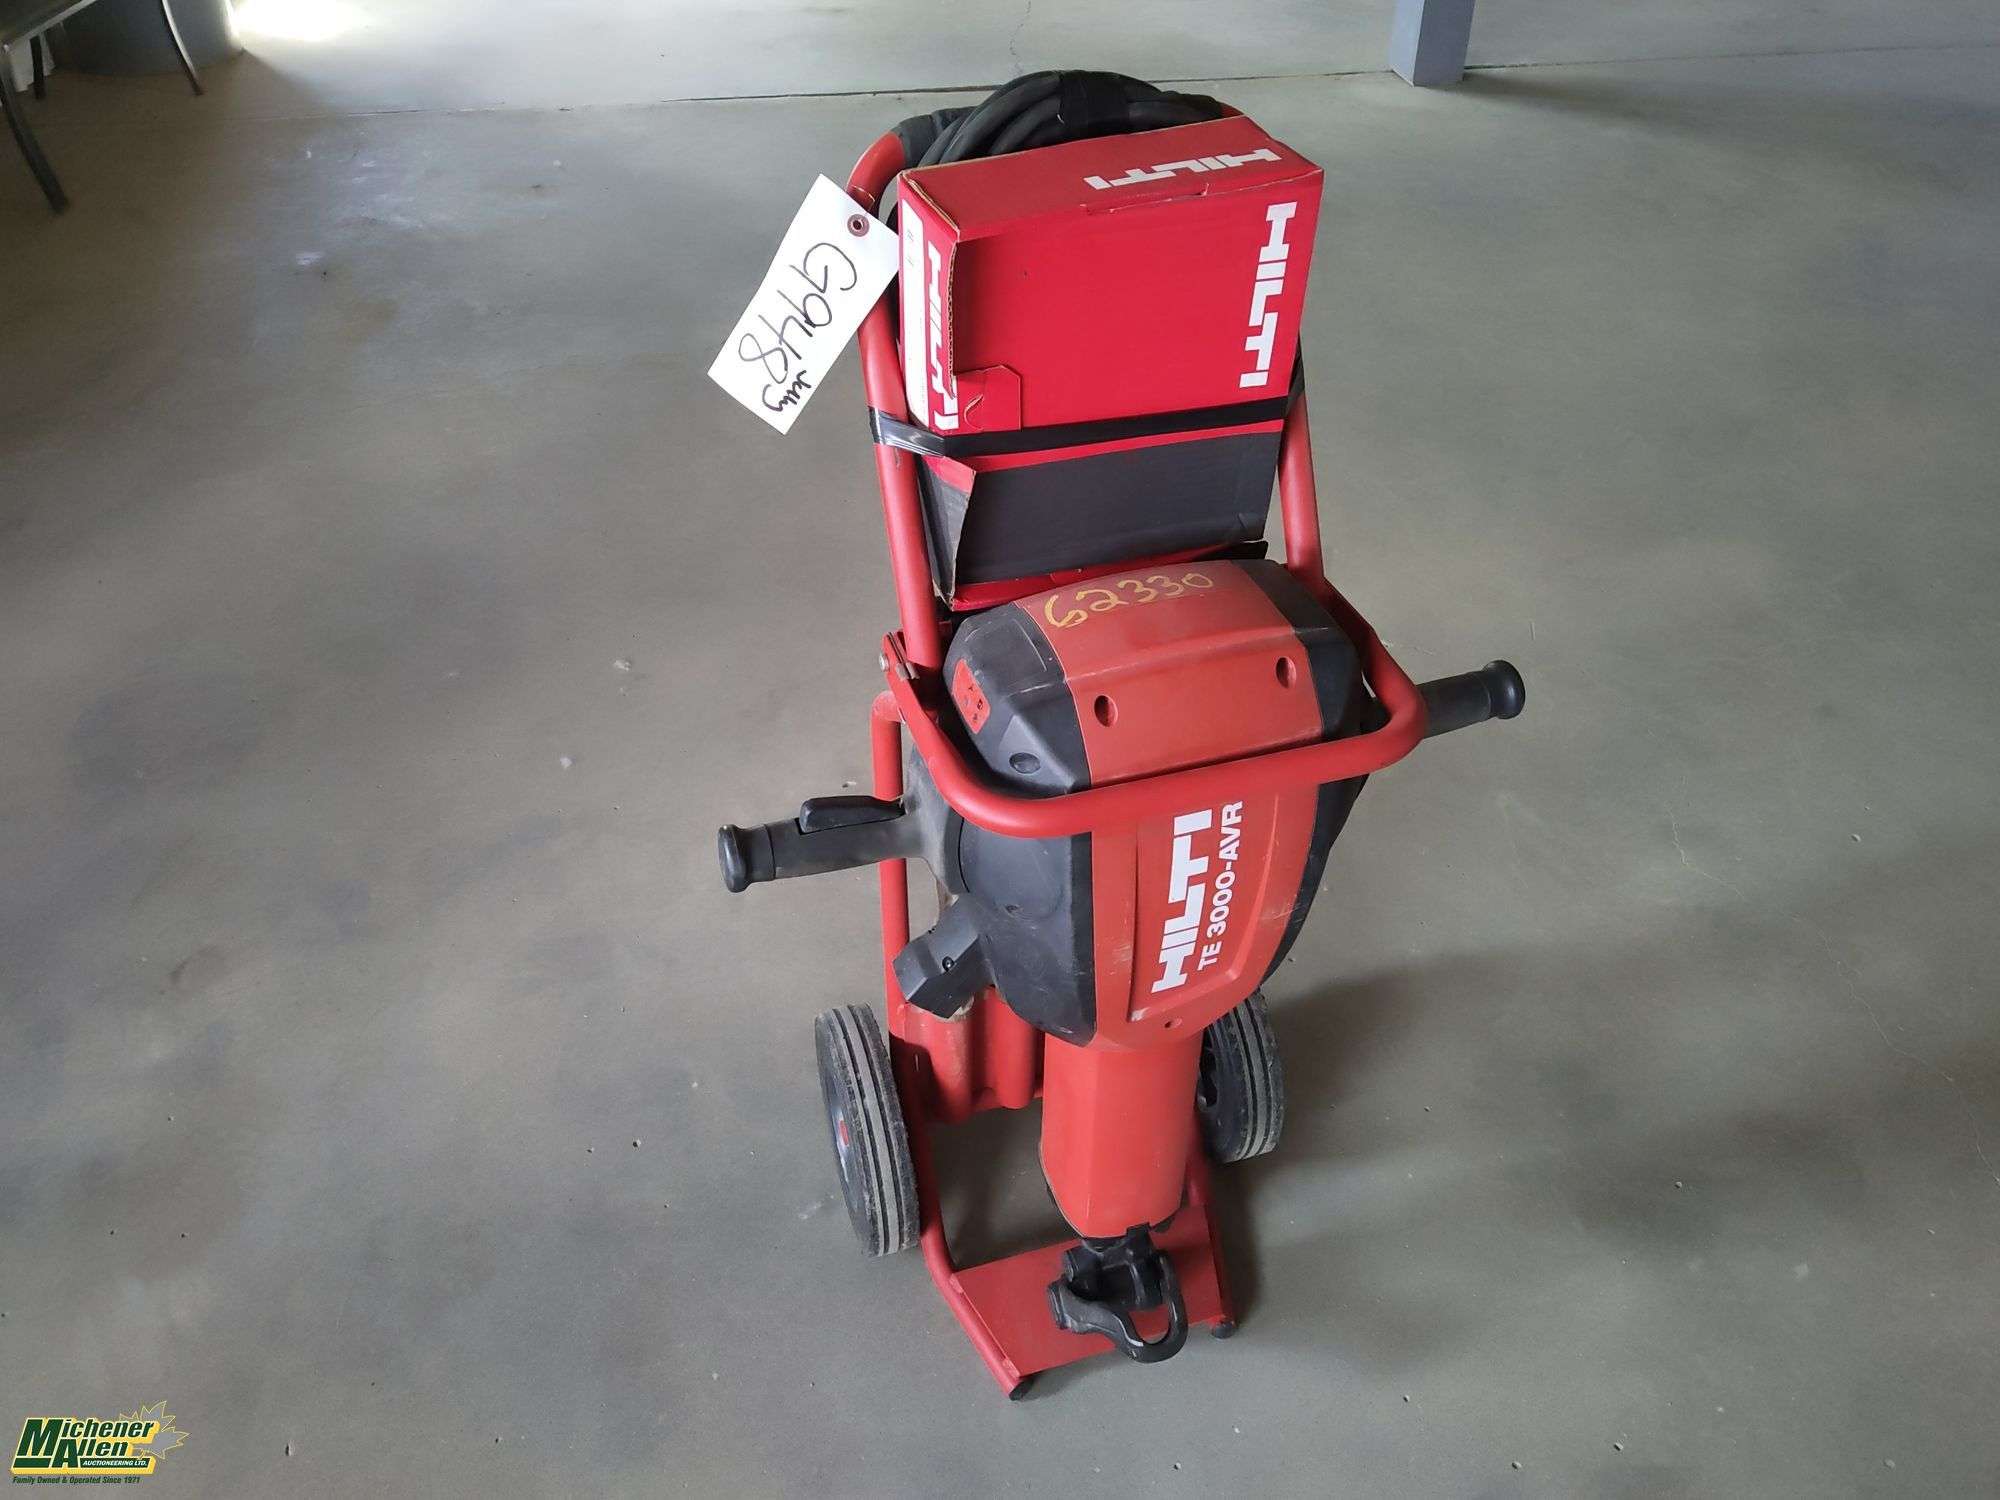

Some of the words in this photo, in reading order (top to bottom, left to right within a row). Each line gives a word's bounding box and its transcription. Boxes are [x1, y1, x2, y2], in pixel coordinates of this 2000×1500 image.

[1083, 148, 1282, 190] HILTI
[1239, 201, 1297, 389] HILTI
[1044, 573, 1214, 628] 62330
[1151, 808, 1213, 994] HILTI
[1206, 800, 1243, 939] 3000-AVR
[1197, 940, 1222, 971] TE
